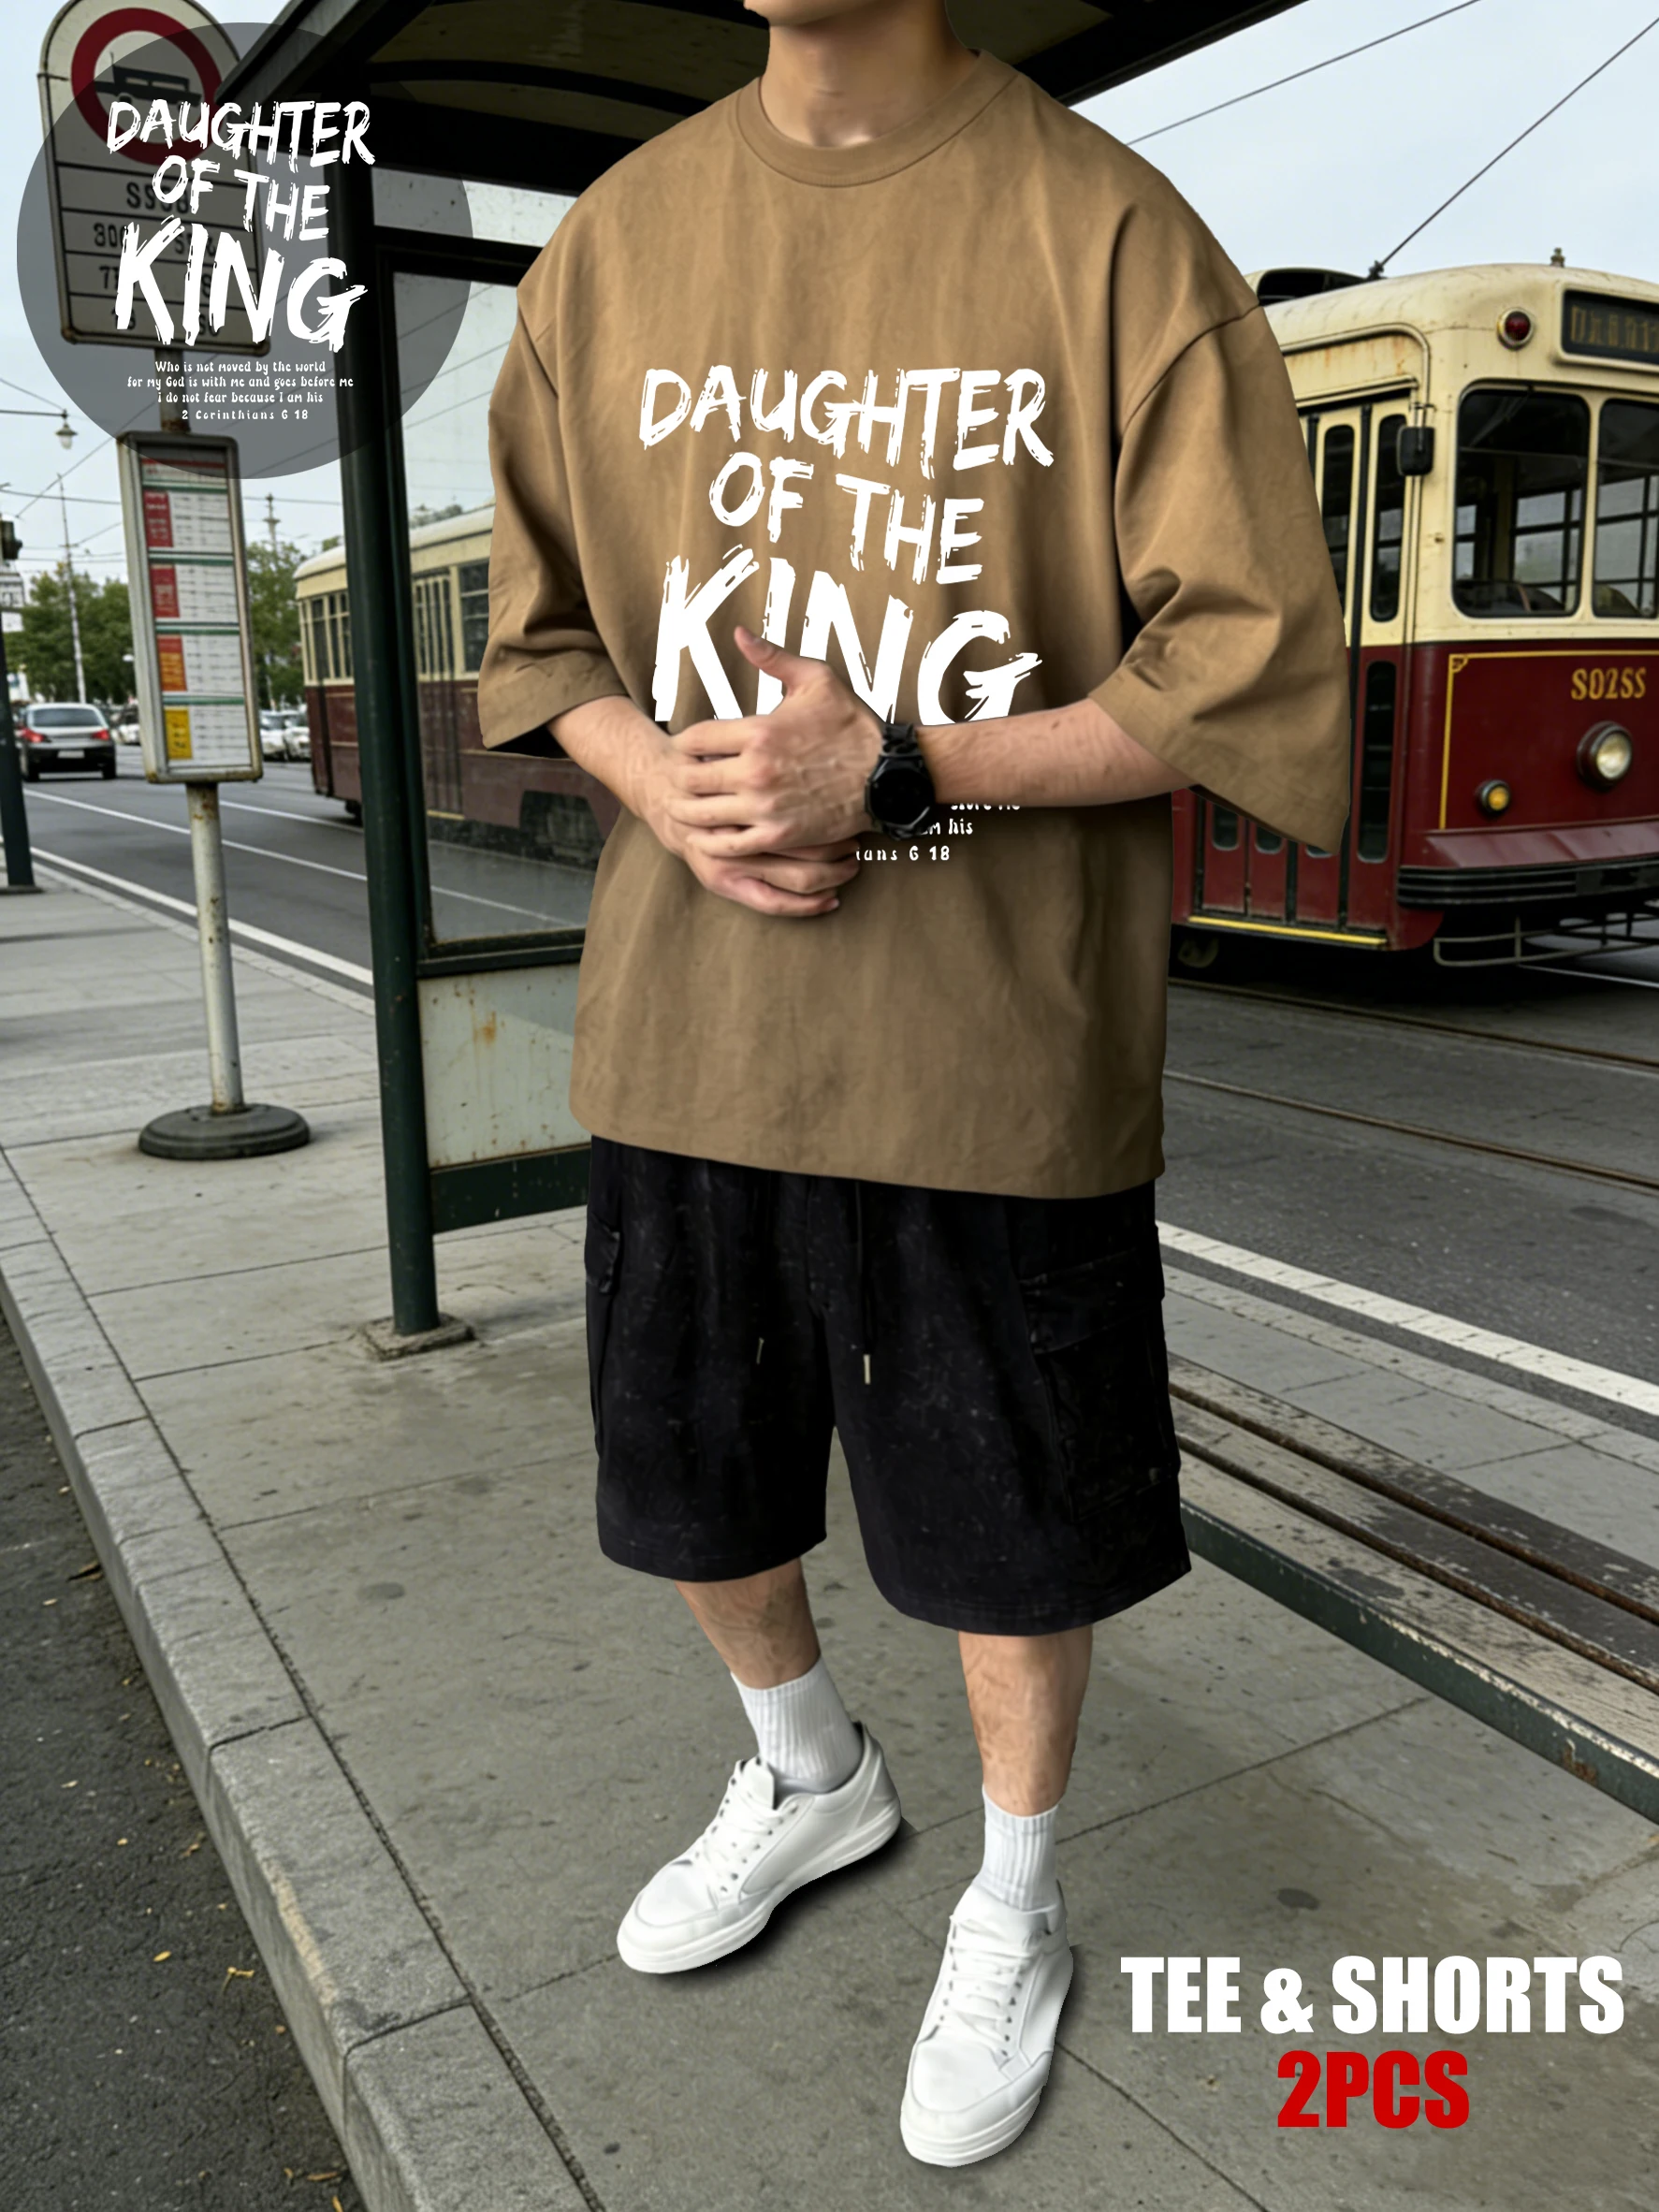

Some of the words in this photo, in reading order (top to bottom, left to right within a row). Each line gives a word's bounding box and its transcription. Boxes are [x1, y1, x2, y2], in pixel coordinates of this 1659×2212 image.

[639, 365, 1054, 479] DAUGHTER
[709, 451, 814, 543] OF
[836, 473, 984, 585] THE
[652, 544, 1042, 726] KING
[929, 845, 950, 861] 18
[948, 818, 973, 835] his
